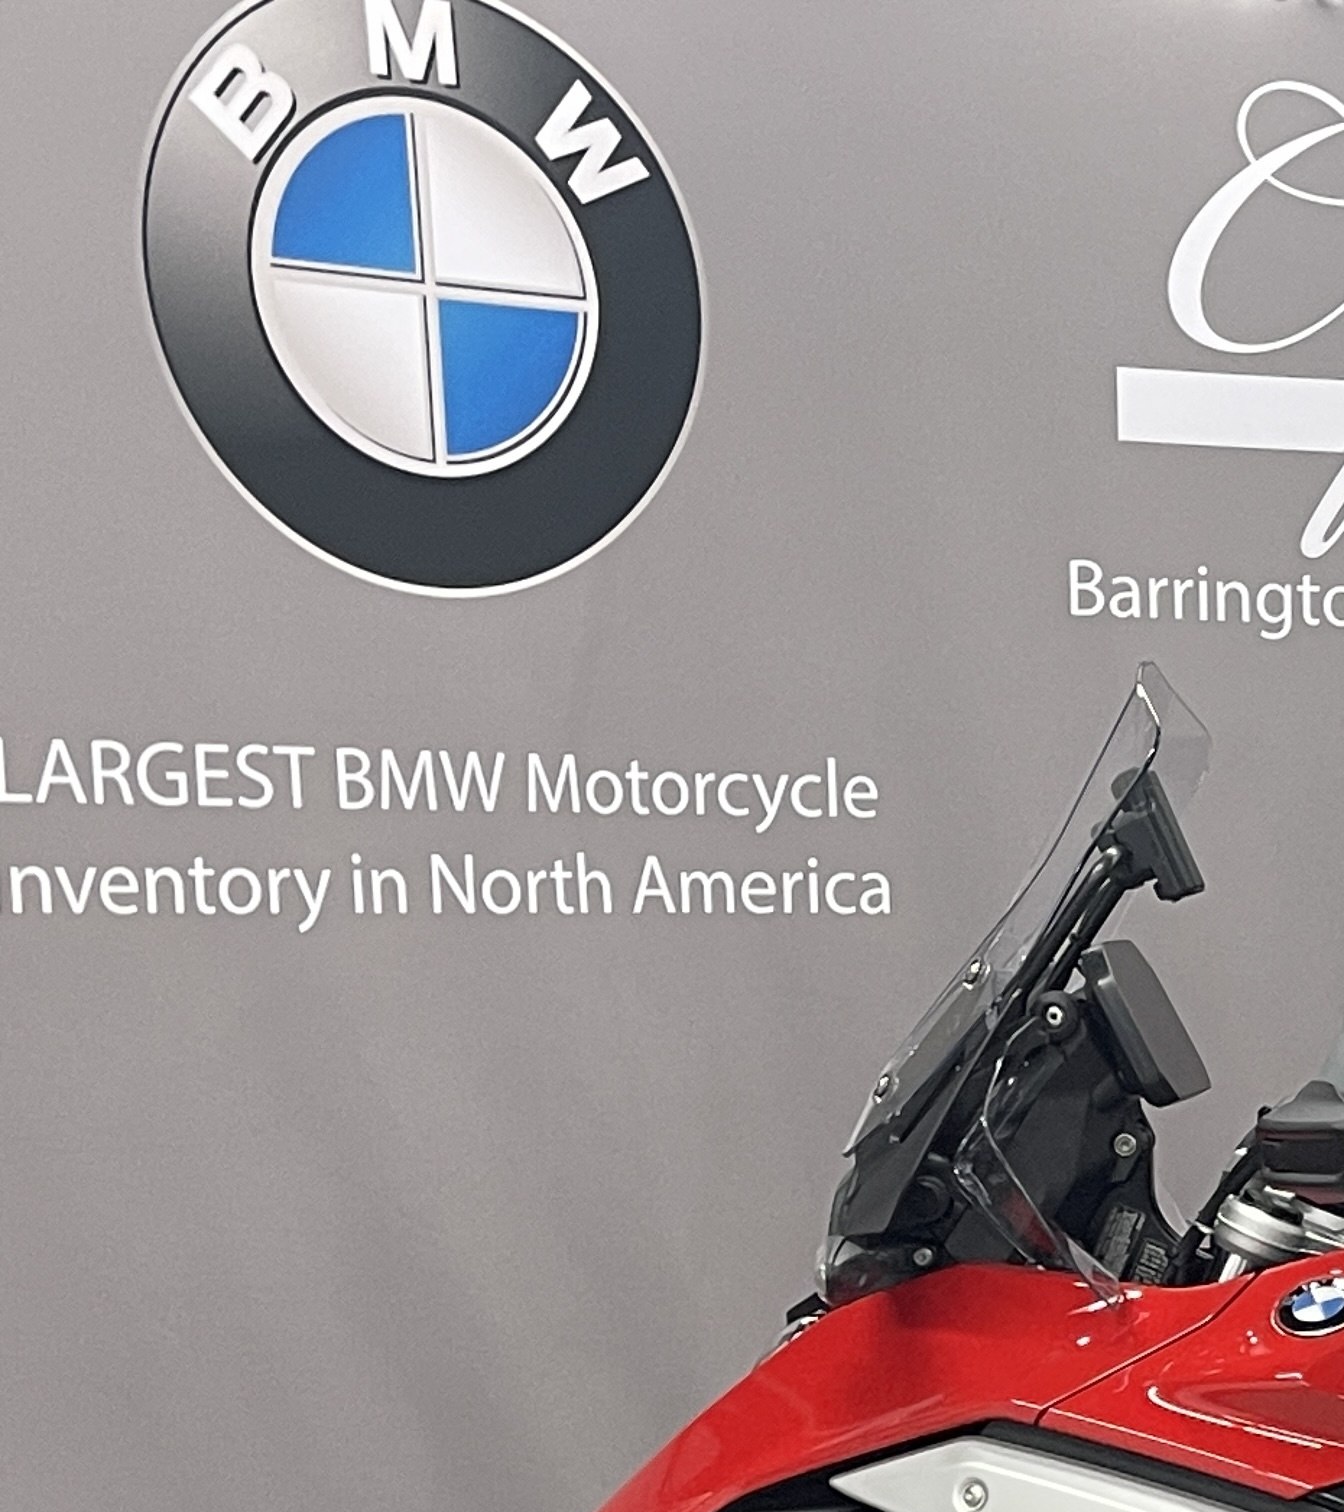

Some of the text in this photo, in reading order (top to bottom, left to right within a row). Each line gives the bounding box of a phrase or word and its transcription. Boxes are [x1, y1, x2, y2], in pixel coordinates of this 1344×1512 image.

[190, 0, 650, 205] BMW
[0, 736, 879, 835] LARGEST BMW Motorcycle
[8, 850, 892, 934] nventory in North America
